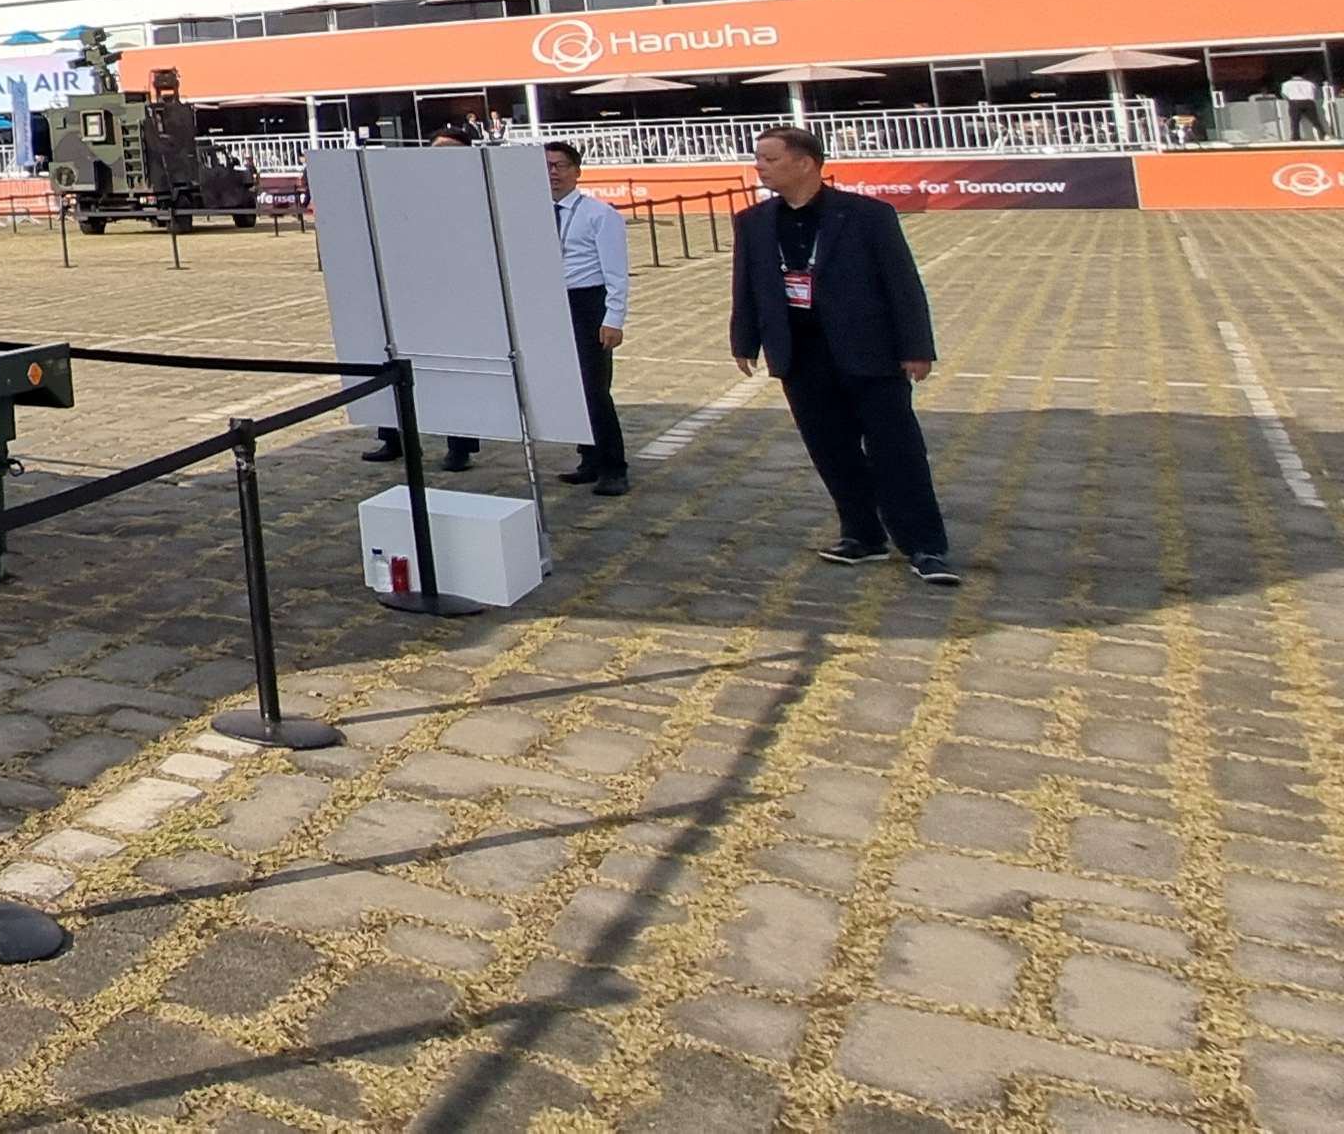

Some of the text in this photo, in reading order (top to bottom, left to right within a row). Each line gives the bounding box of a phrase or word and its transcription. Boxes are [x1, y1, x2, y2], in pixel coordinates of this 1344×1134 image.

[609, 23, 778, 55] Hanwha
[33, 70, 81, 93] AIR
[579, 183, 648, 198] anwha
[918, 179, 949, 195] for
[954, 178, 1066, 195] Tomorrow
